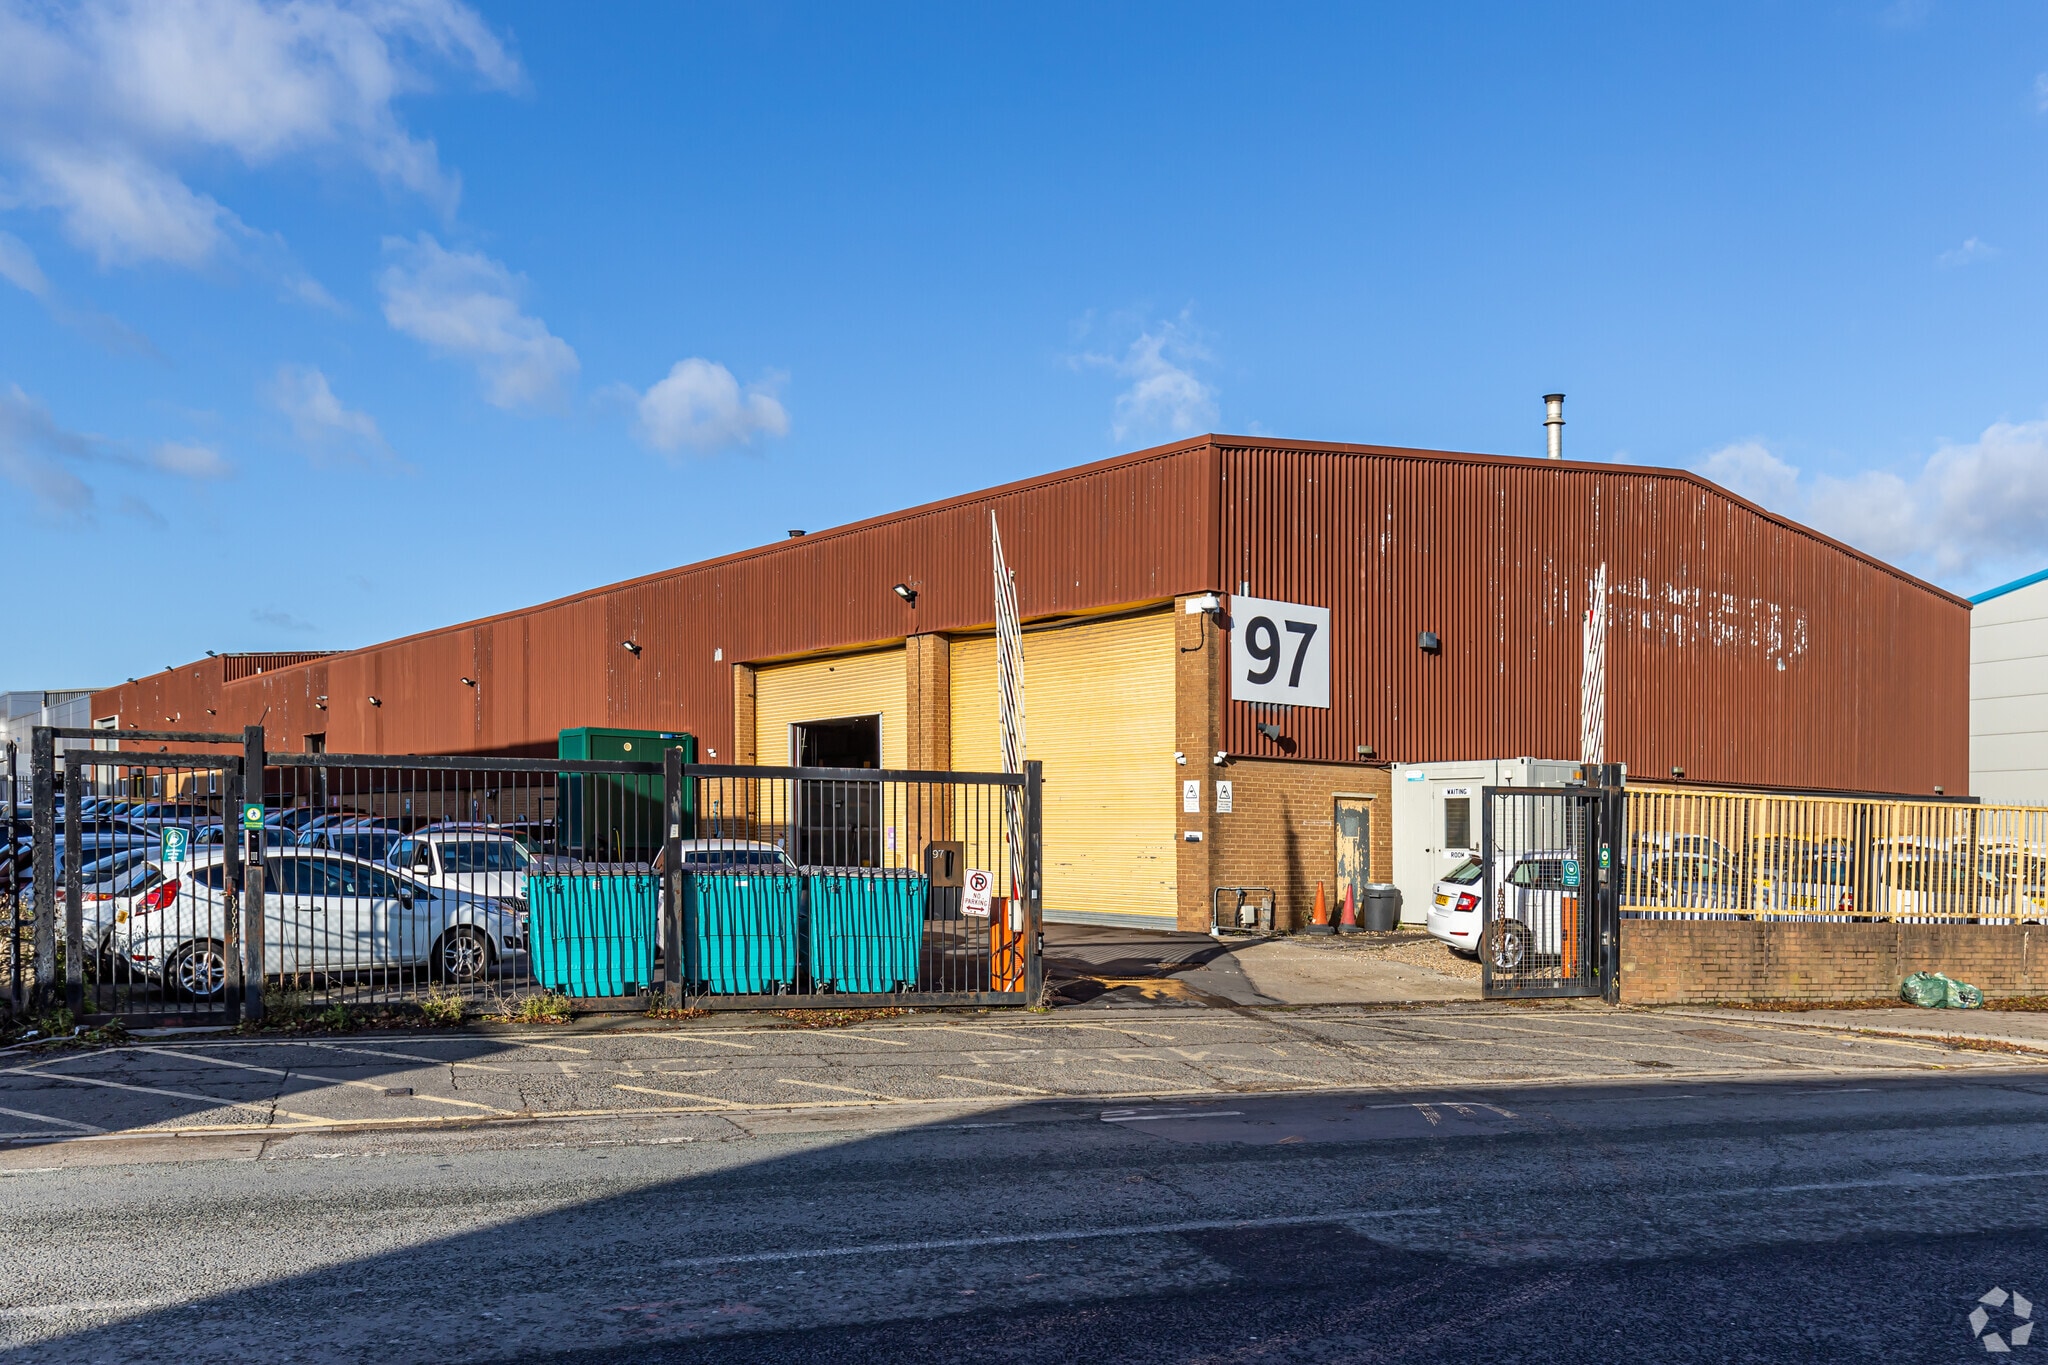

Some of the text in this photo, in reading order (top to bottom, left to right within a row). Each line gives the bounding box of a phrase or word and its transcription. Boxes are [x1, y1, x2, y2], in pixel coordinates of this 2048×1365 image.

[1245, 615, 1318, 688] 97
[932, 850, 944, 859] 97
[965, 898, 987, 906] PARKING
